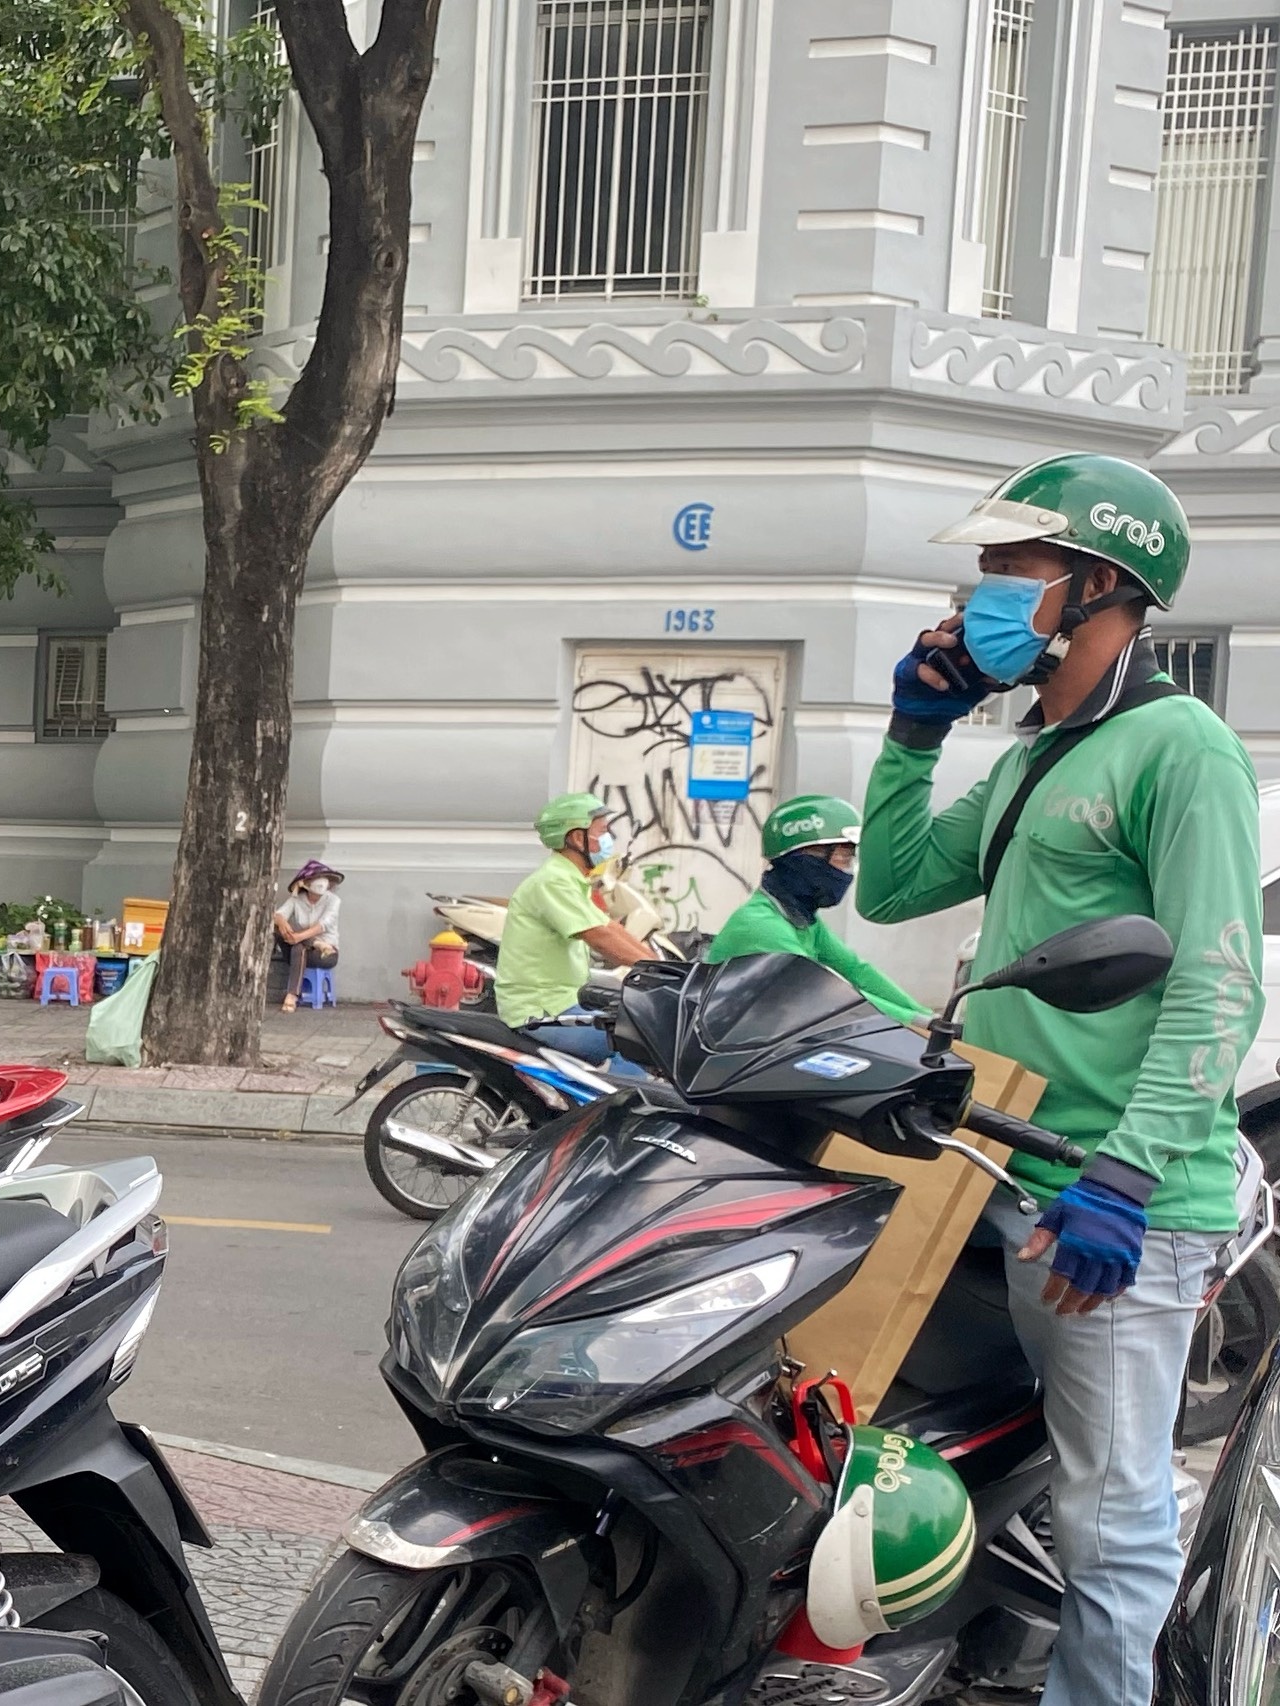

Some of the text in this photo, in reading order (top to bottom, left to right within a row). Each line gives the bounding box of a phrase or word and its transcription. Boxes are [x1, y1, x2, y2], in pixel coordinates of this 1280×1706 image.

[1089, 501, 1166, 557] Grab
[664, 608, 716, 633] 1963
[781, 813, 825, 837] Grab
[1042, 783, 1114, 830] Grab
[1188, 919, 1255, 1101] Grab
[873, 1433, 916, 1494] Grab
